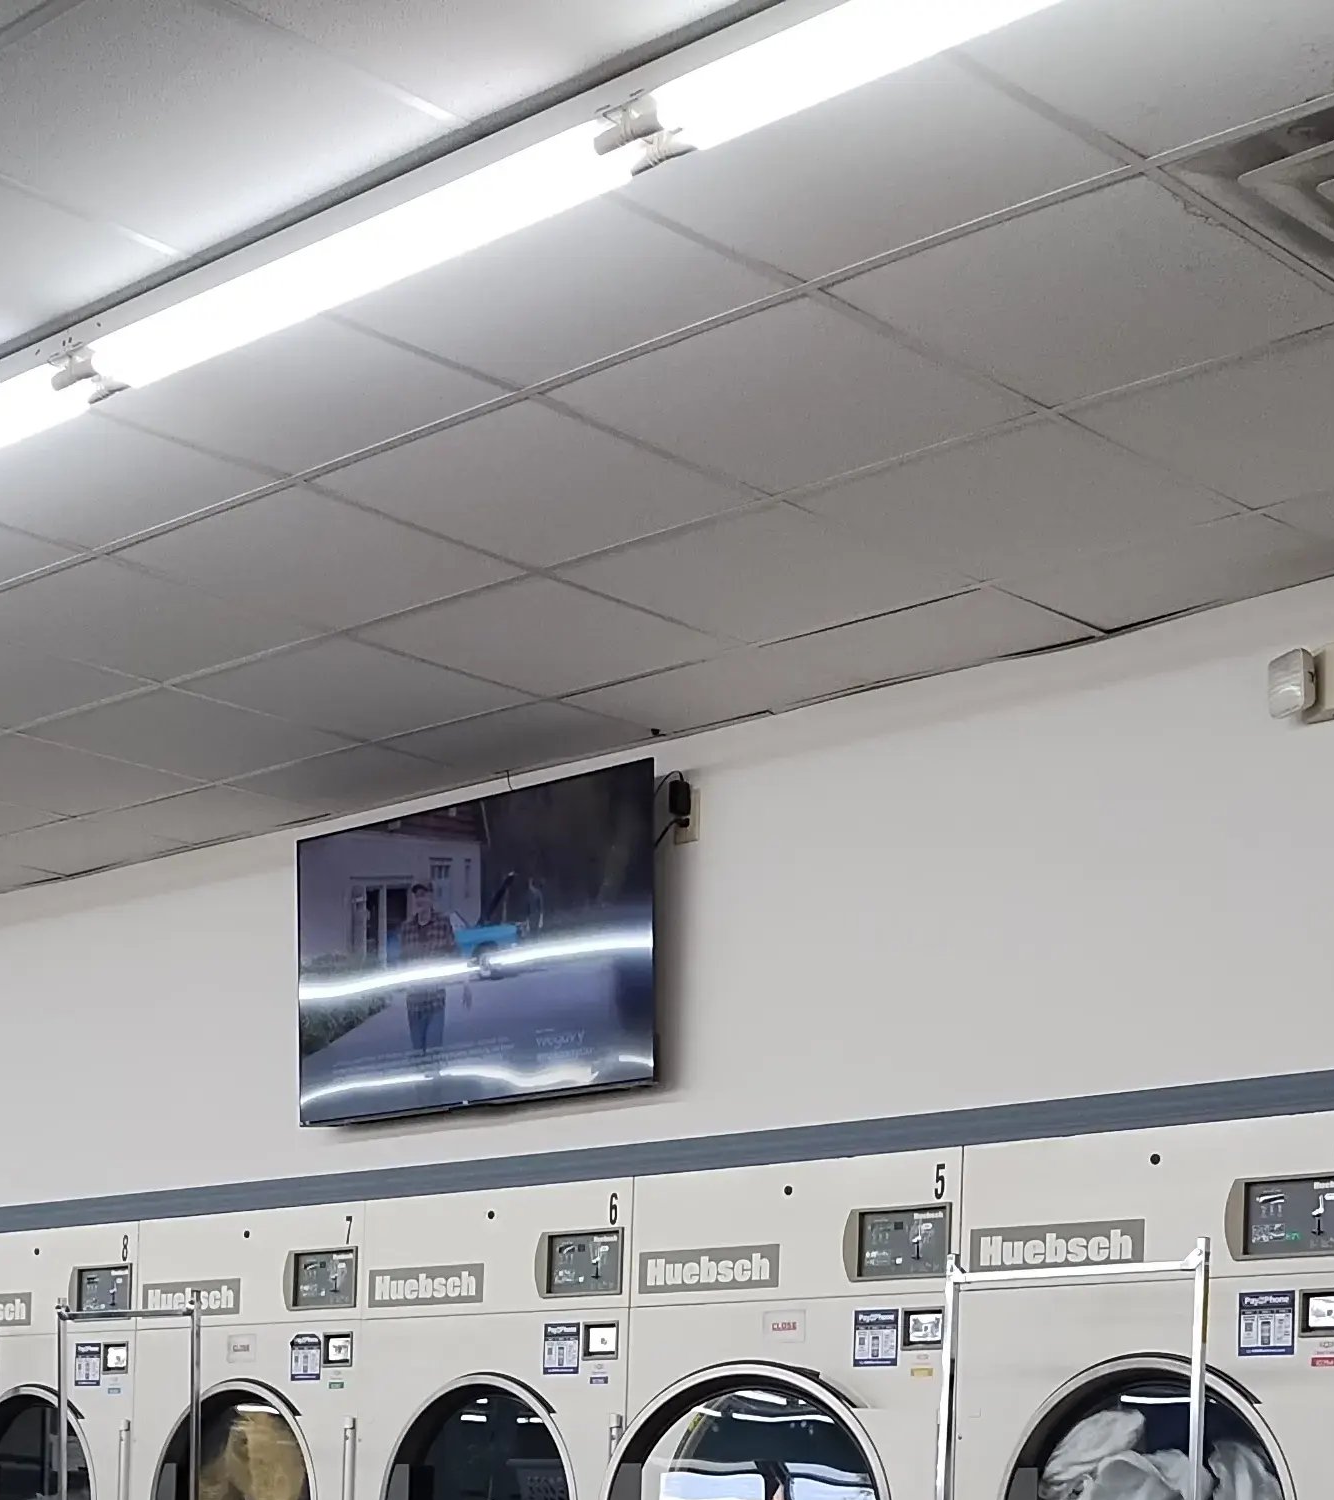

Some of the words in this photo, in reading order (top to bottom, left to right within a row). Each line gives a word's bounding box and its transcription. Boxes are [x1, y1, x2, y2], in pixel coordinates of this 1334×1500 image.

[934, 1163, 946, 1200] 5
[609, 1192, 619, 1226] 6
[345, 1215, 353, 1245] 7
[121, 1234, 129, 1262] 8
[979, 1229, 1133, 1268] Huebsch
[375, 1270, 477, 1300] Huebsch
[646, 1253, 770, 1287] Huebsch
[771, 1321, 797, 1332] CLOSE
